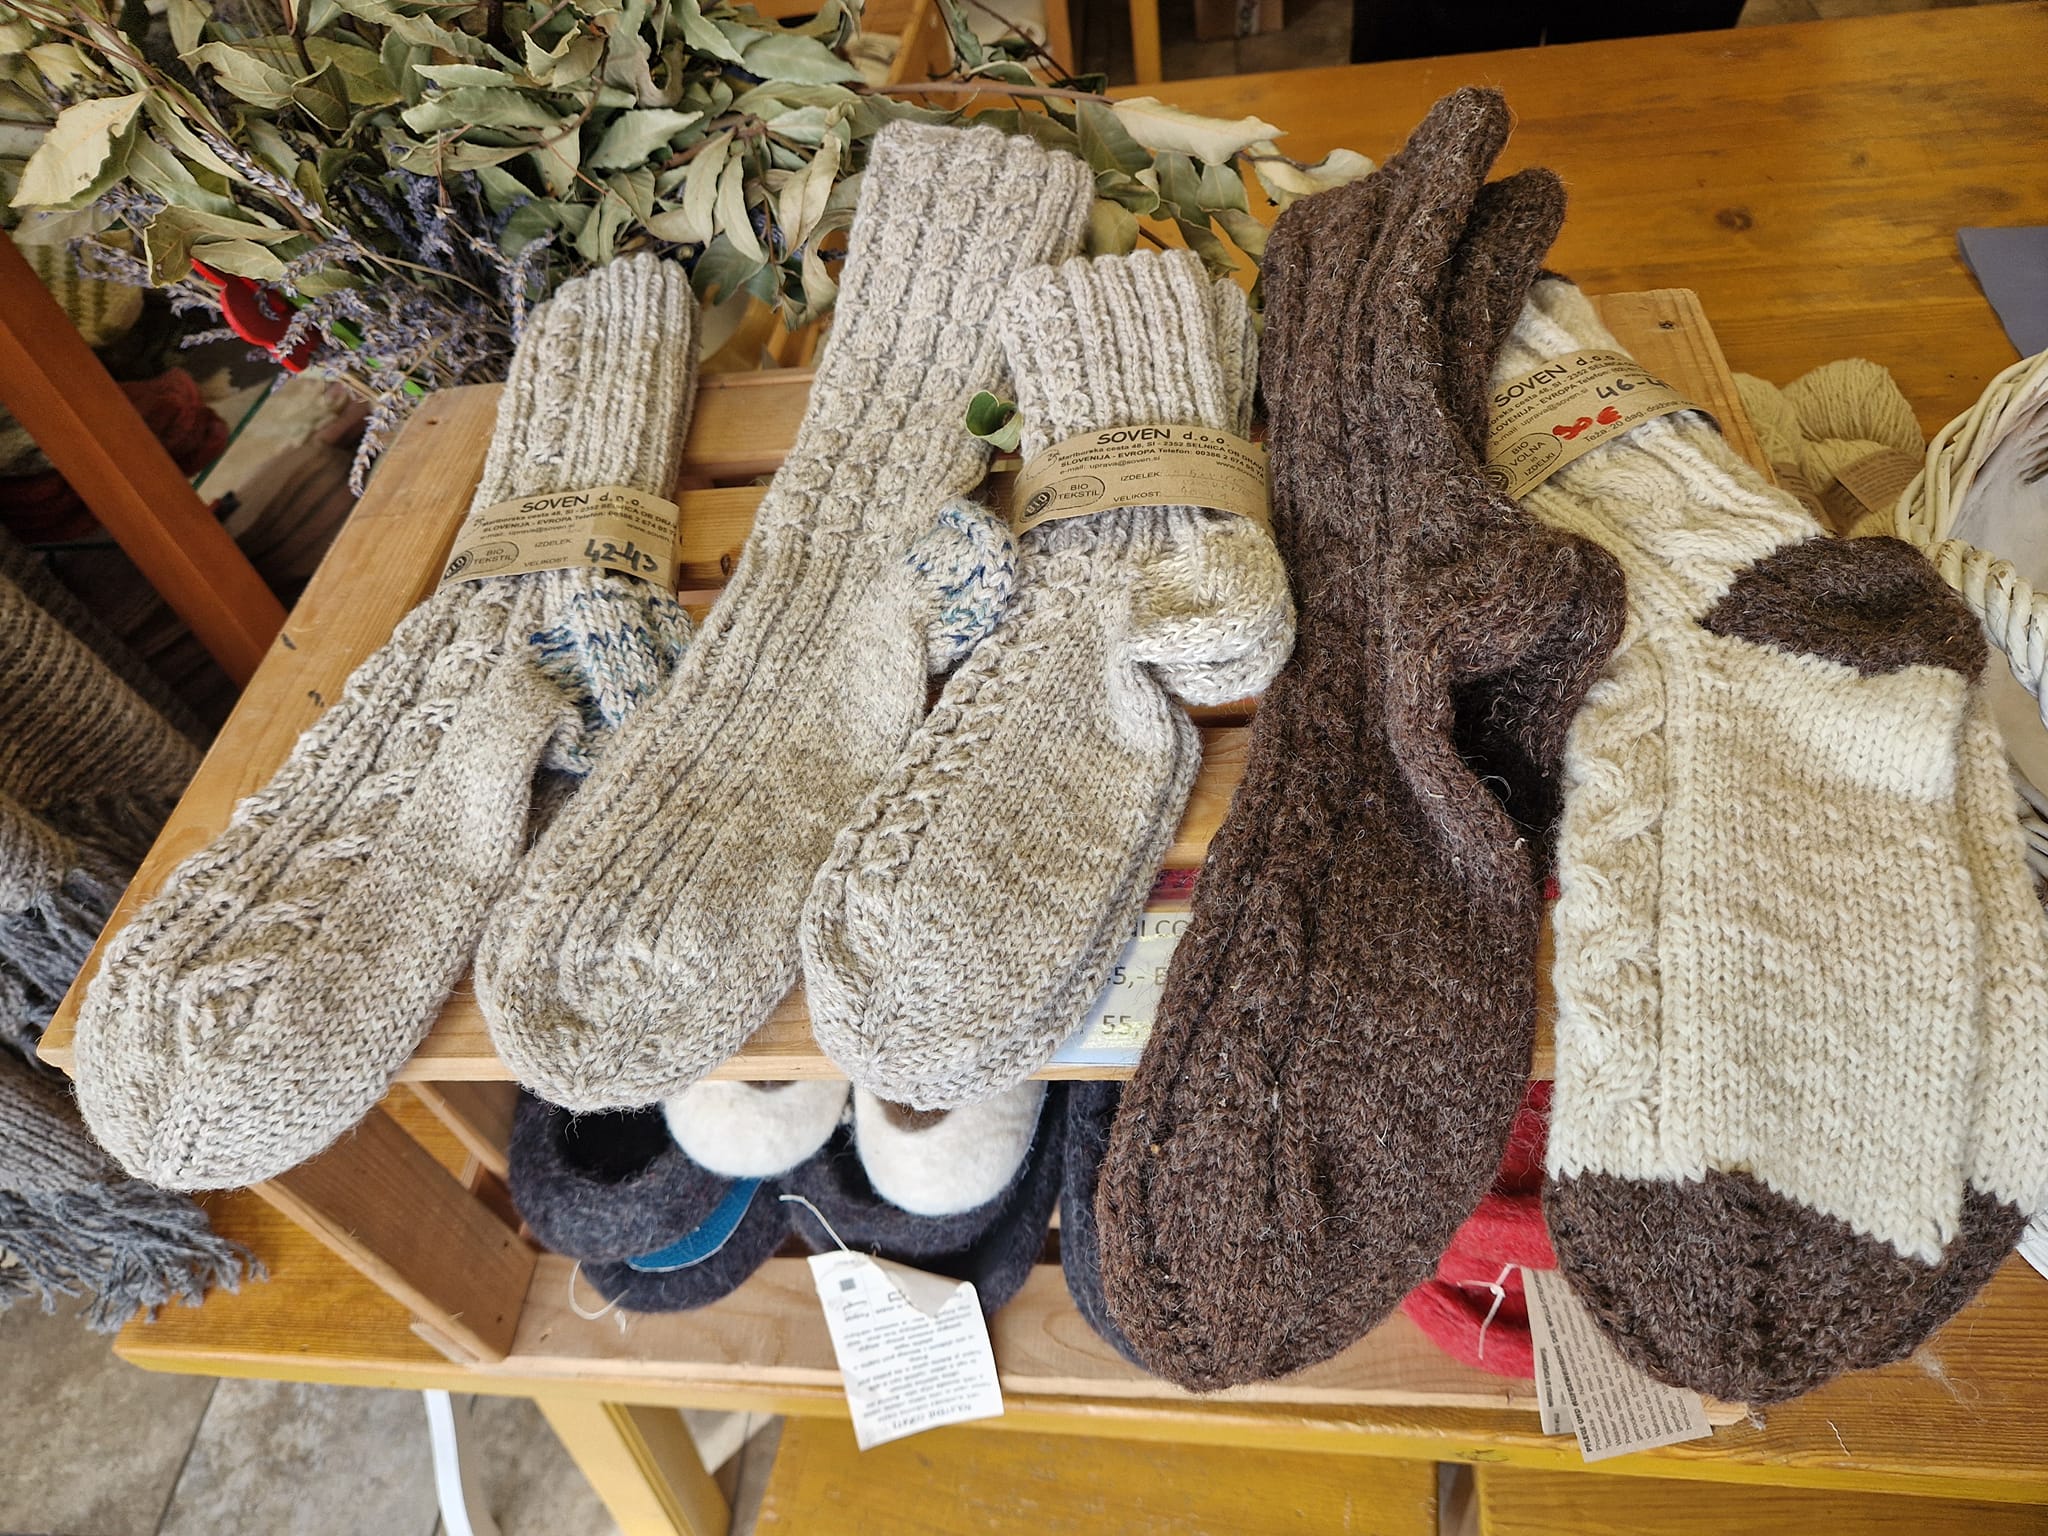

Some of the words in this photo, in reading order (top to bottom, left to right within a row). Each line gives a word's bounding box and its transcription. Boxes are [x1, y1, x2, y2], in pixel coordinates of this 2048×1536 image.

[1494, 364, 1567, 408] SOVEN
[1540, 382, 1577, 404] EVROPA
[1514, 393, 1538, 408] cesta
[1097, 428, 1170, 445] SOVEN
[1183, 431, 1230, 447] d.o.o.
[1058, 447, 1104, 461] Mariborska
[1186, 442, 1226, 452] SELNICA
[1227, 449, 1240, 457] OB
[1510, 440, 1546, 468] VOLNA
[1511, 440, 1529, 455] BIO
[1061, 454, 1110, 468] SLOVENIJA
[1118, 448, 1156, 459] EVROPA
[1523, 452, 1556, 477] IZDELKI
[1121, 471, 1160, 481] IZDELEK
[1058, 490, 1100, 500] TEKSTIL
[1070, 483, 1089, 491] BIO
[520, 494, 589, 513] SOVEN
[1026, 493, 1049, 514] BIO
[537, 516, 572, 526] EVROPA
[474, 554, 513, 565] TEKSTIL
[487, 548, 504, 556] BIO
